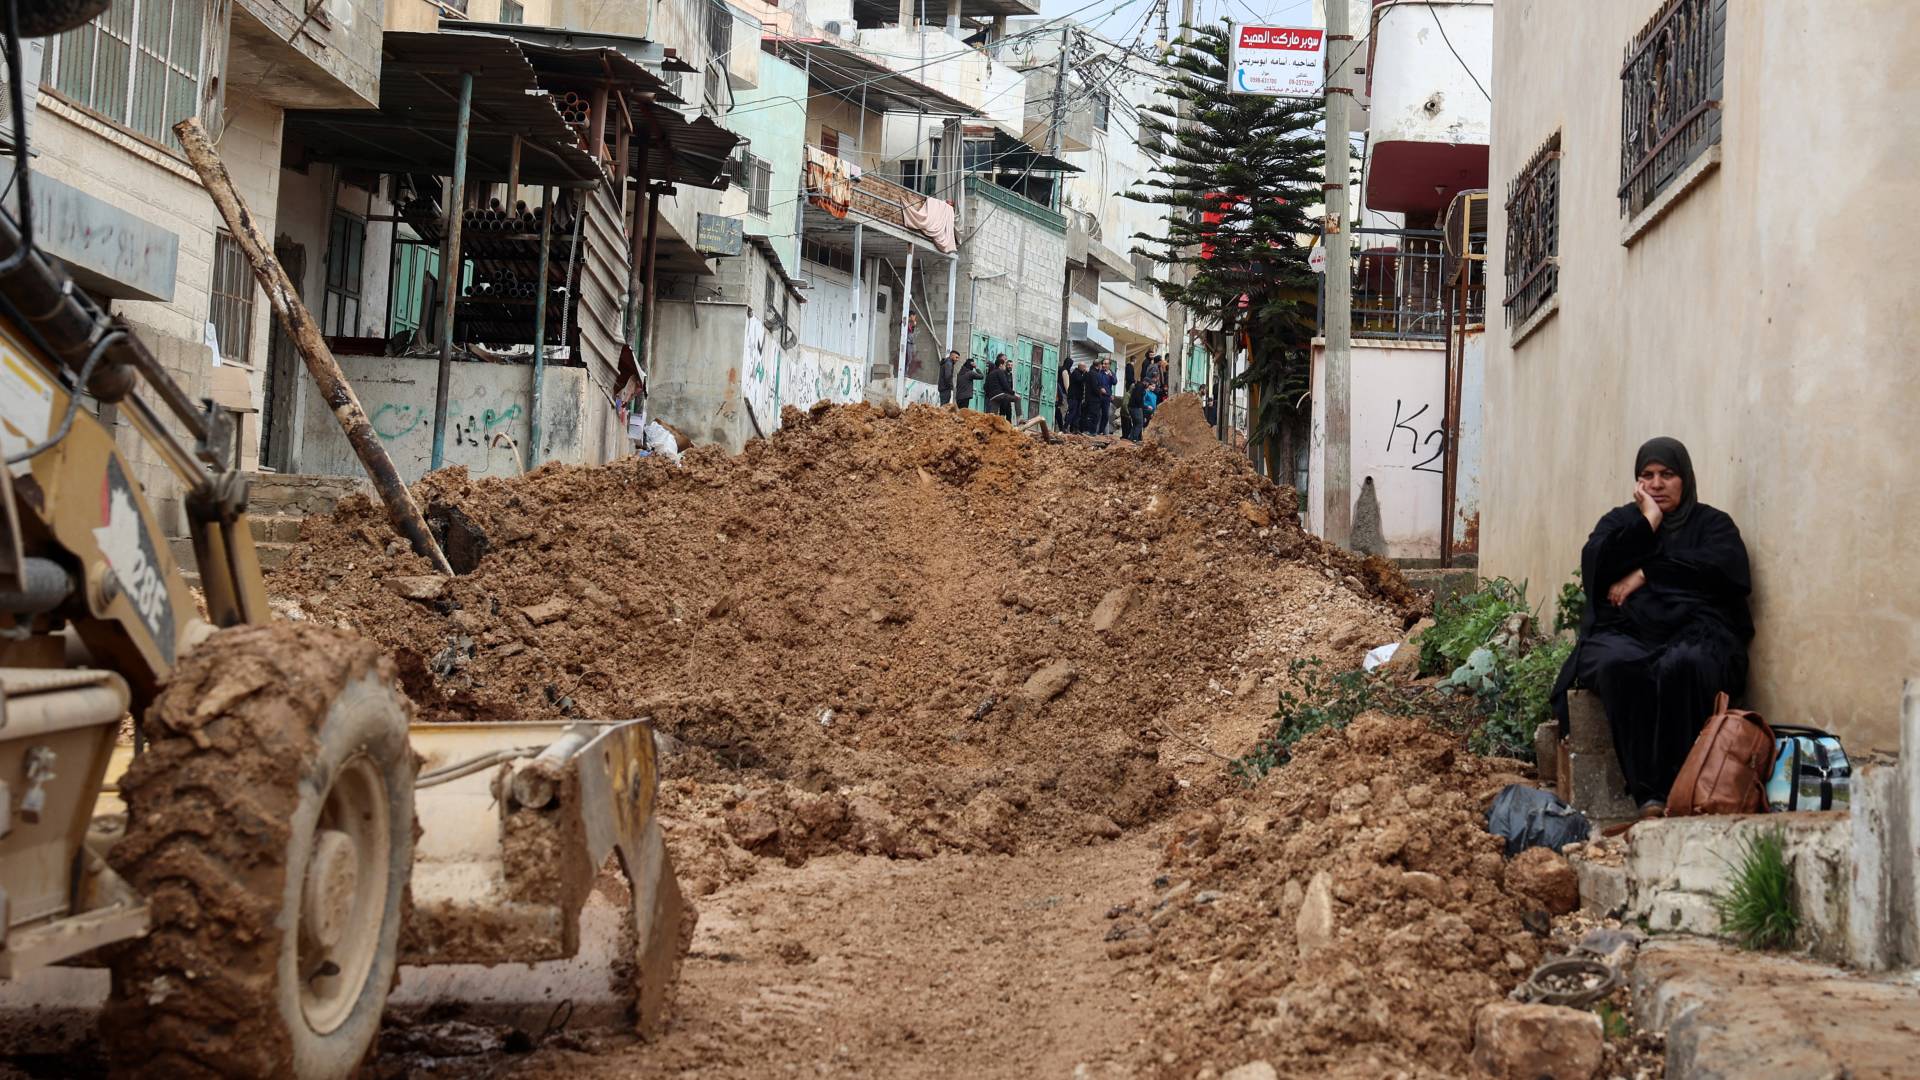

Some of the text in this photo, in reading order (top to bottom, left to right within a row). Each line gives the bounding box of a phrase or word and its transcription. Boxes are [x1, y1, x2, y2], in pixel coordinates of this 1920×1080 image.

[1243, 30, 1319, 49] سوبر ماركت العميد
